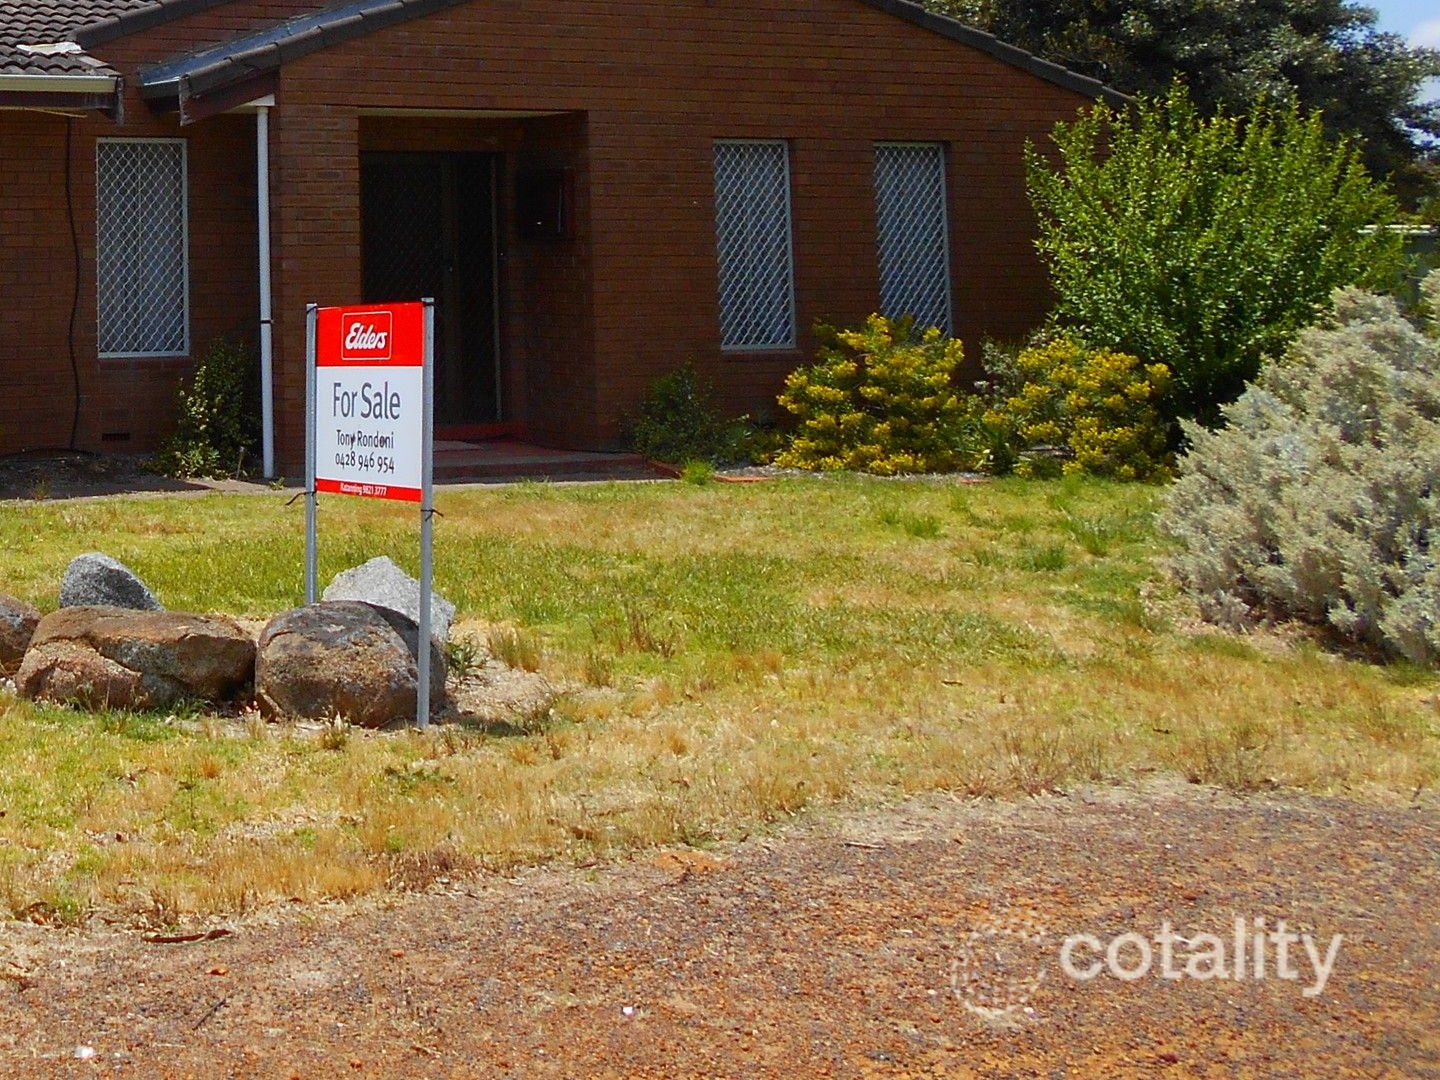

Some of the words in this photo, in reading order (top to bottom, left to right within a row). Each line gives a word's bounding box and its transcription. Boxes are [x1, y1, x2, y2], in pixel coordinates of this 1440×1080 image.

[344, 322, 388, 350] Elders
[333, 382, 358, 418] For
[360, 381, 401, 420] Sale
[336, 429, 356, 450] Tony
[357, 430, 394, 449] Rondoni
[335, 450, 356, 470] 0428
[358, 451, 375, 472] 946
[377, 456, 395, 474] 954
